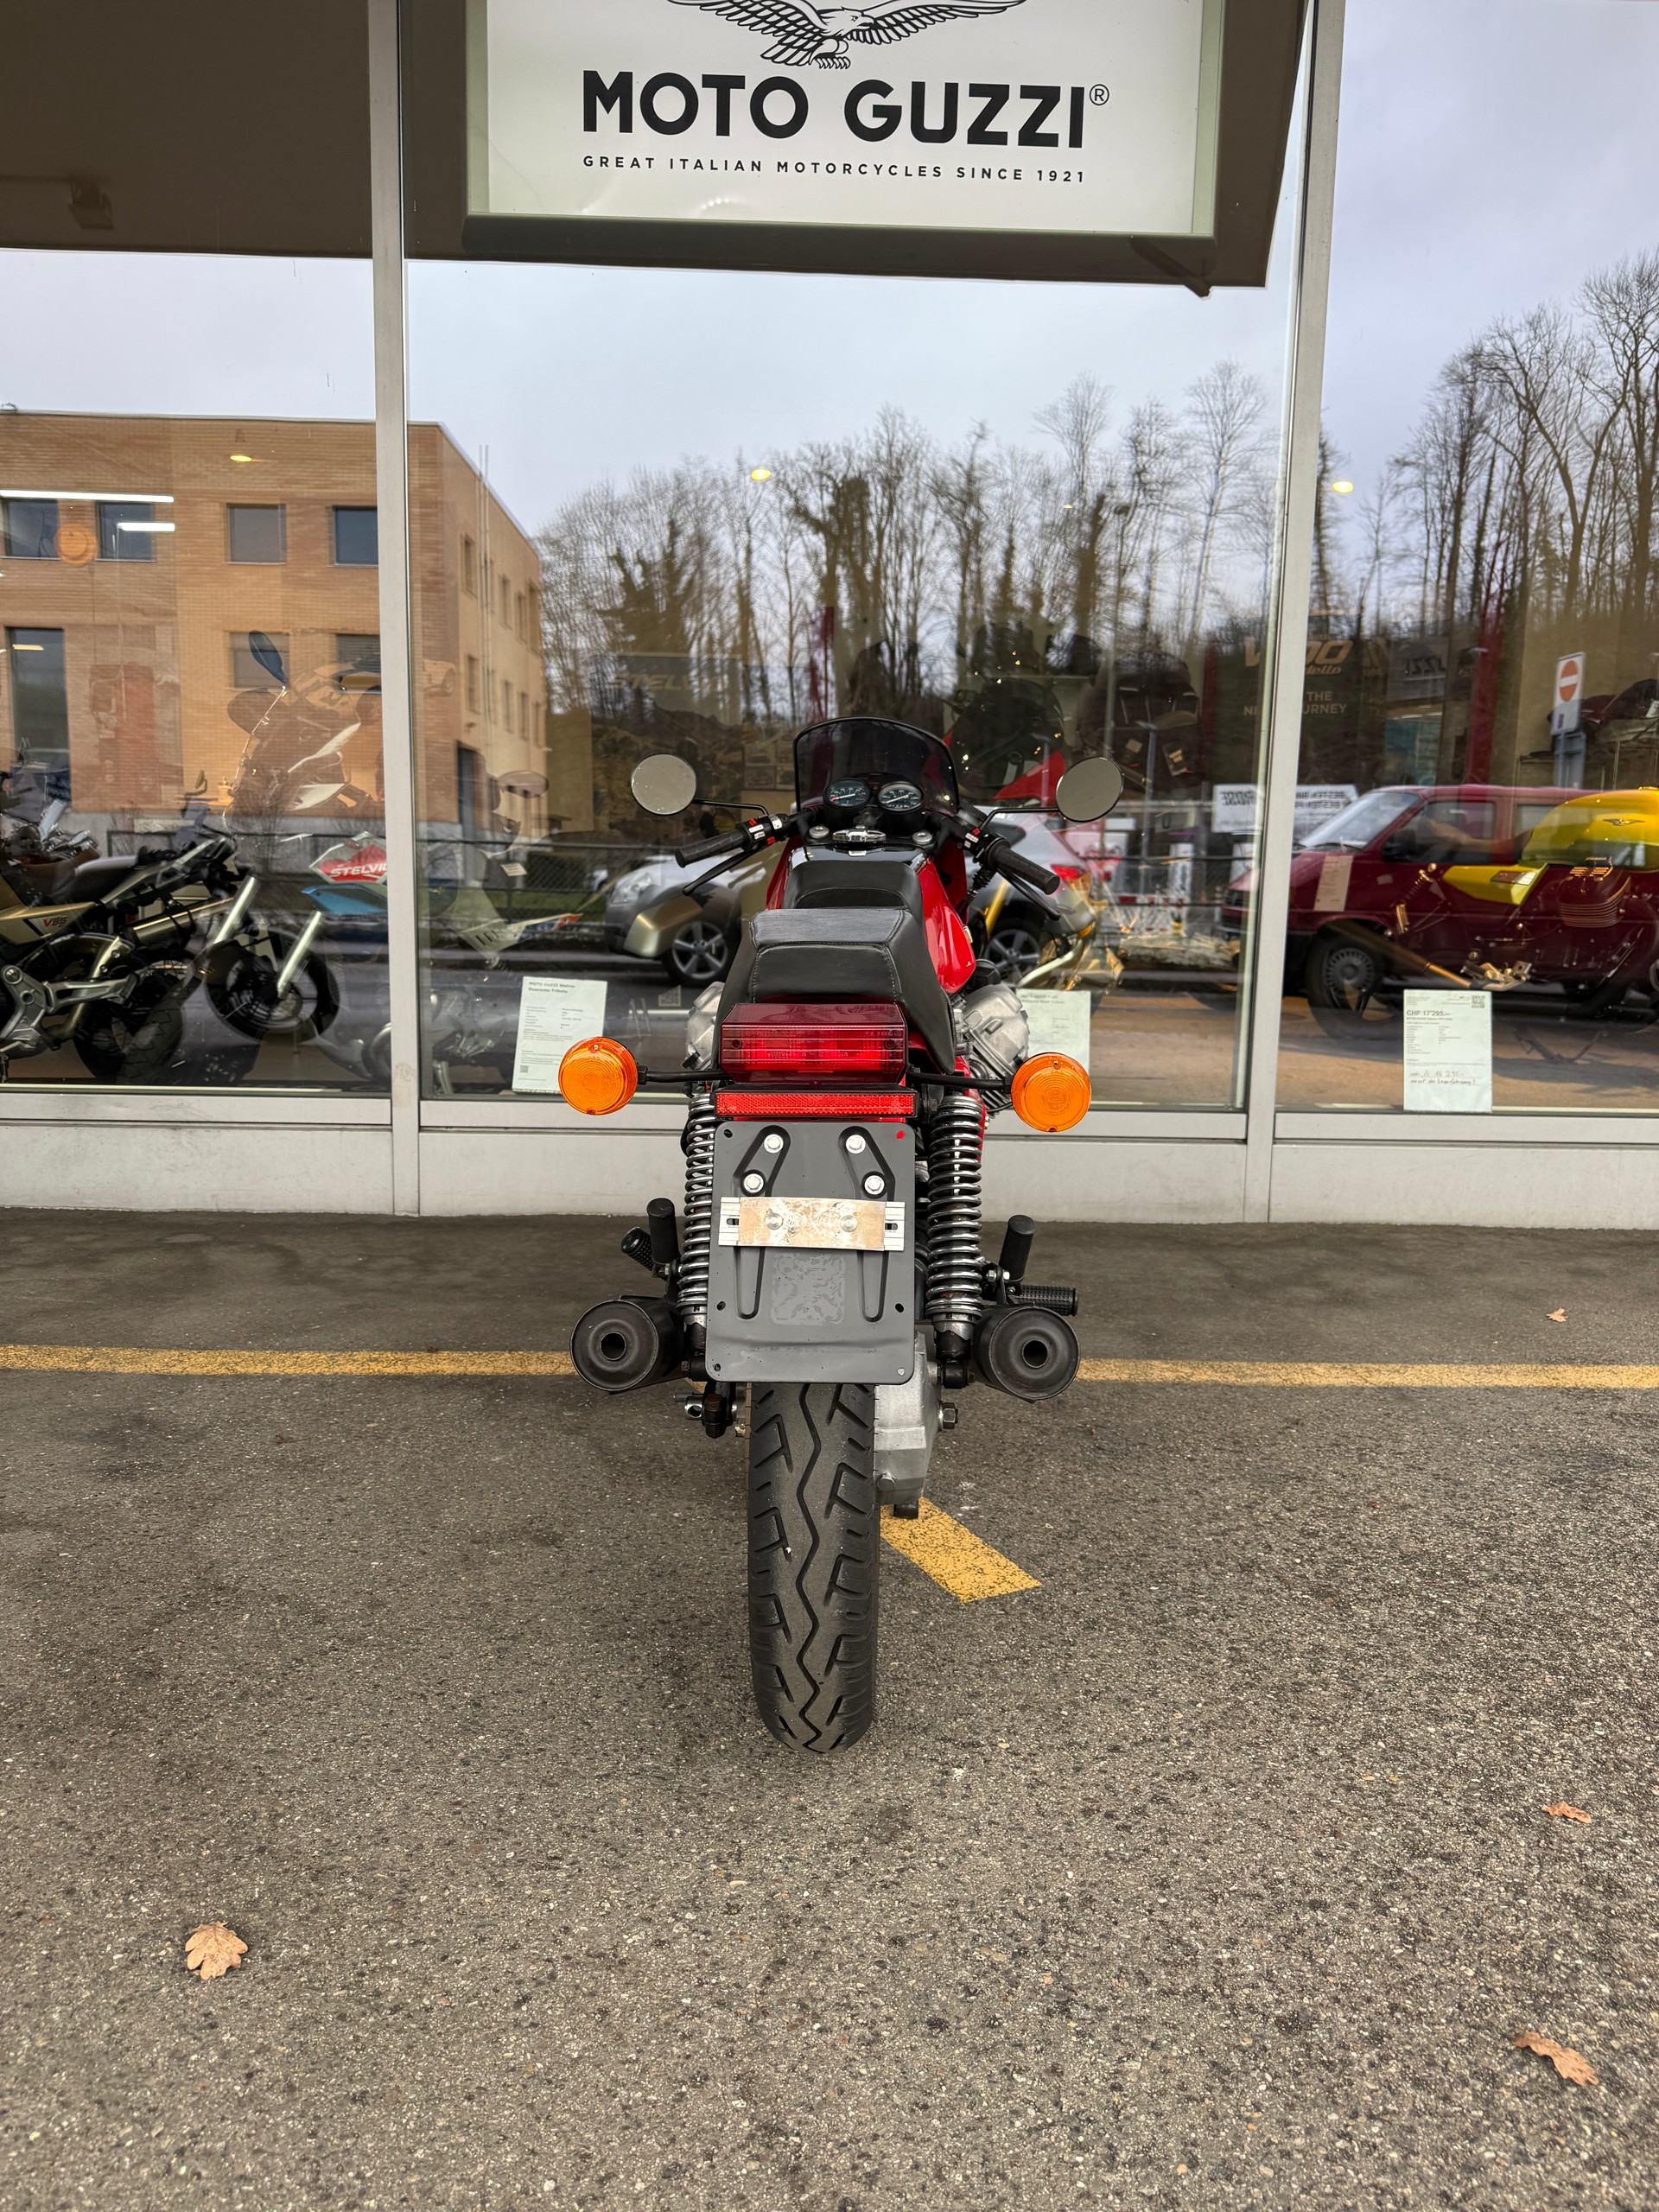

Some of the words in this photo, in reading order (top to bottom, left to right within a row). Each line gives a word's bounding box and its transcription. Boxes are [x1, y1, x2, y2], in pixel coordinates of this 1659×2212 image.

[583, 70, 809, 139] MOTO
[583, 156, 654, 168] GREAT
[670, 158, 761, 172] ITALIAN
[777, 162, 942, 177] MOTORCYCLES
[957, 167, 1022, 181] SINCE
[1037, 169, 1084, 183] 1921
[1306, 690, 1332, 702] THE
[42, 916, 68, 927] V85
